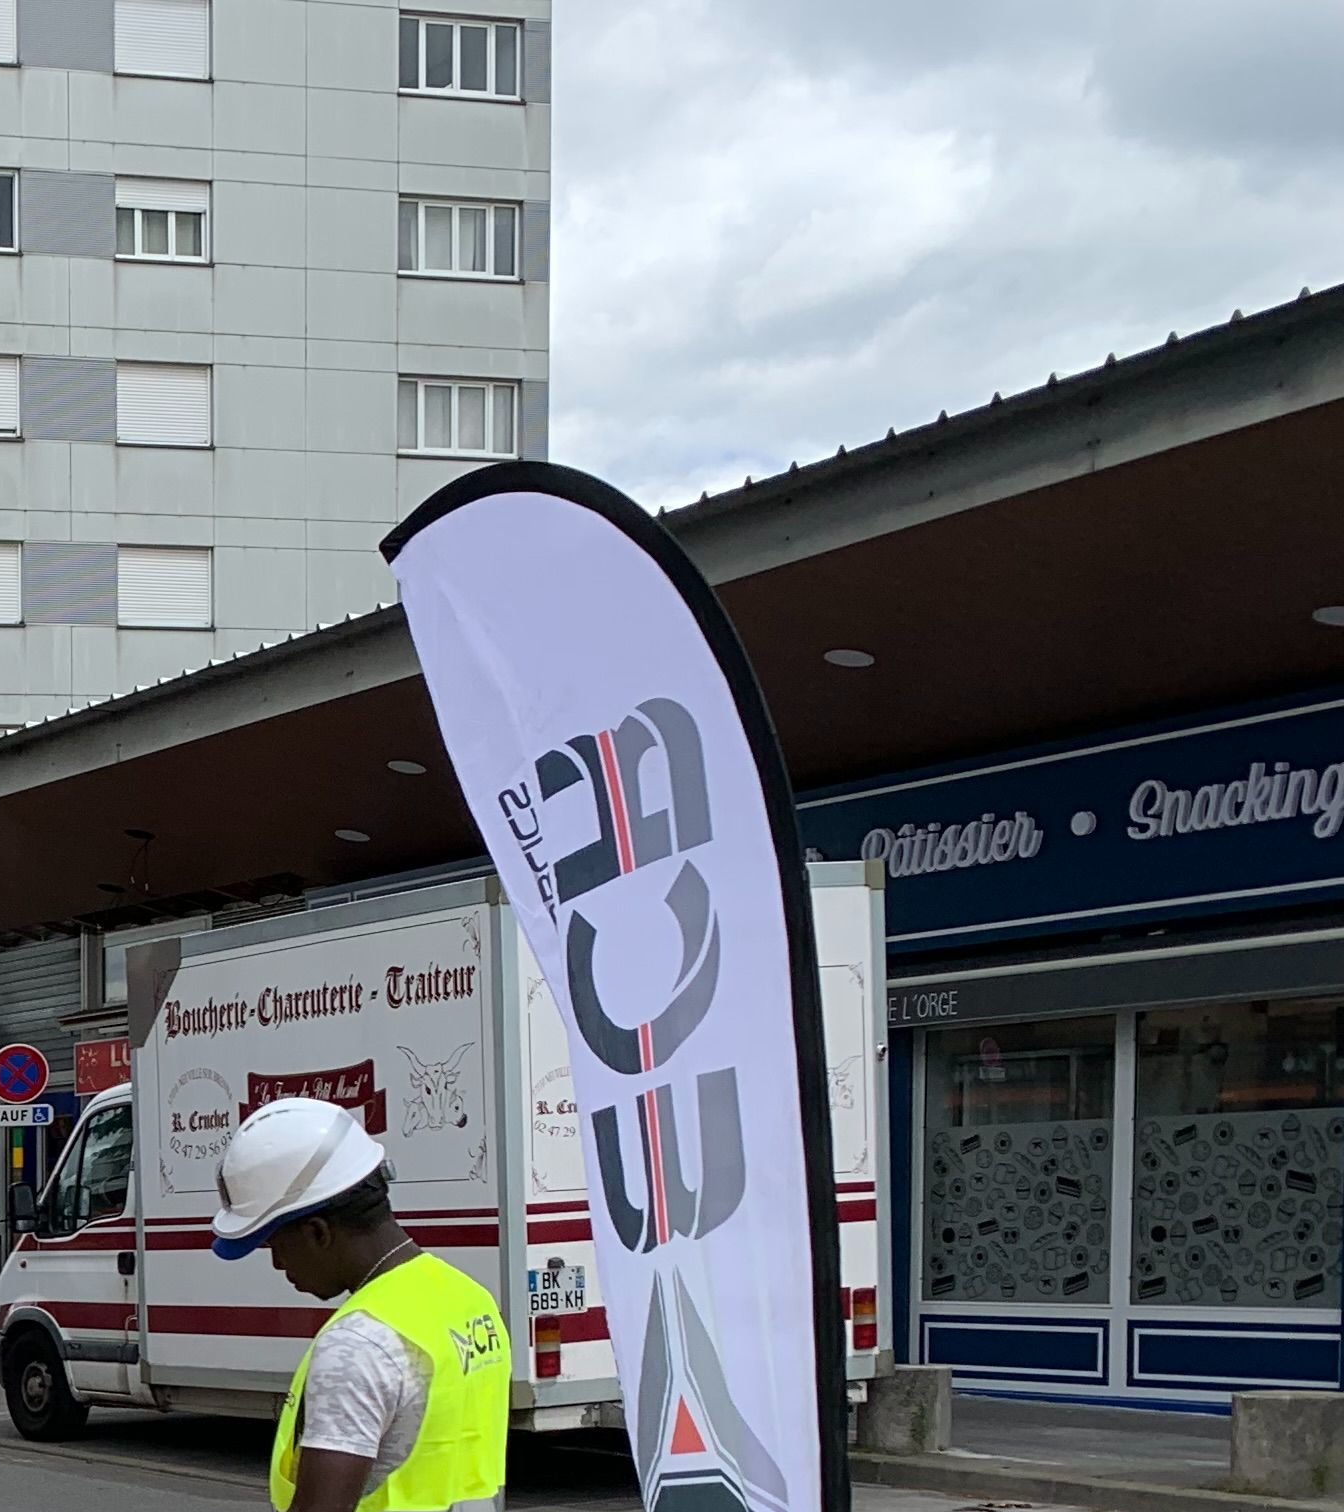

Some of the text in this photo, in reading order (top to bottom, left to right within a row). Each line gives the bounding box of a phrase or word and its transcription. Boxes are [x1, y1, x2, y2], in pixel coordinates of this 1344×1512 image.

[1127, 762, 1344, 840] Snacking
[862, 811, 1044, 878] Pâtissier
[386, 962, 476, 1009] Traiteur
[902, 991, 958, 1020] L'ORGE
[542, 1270, 560, 1289] BK
[530, 1290, 584, 1310] 689-KH
